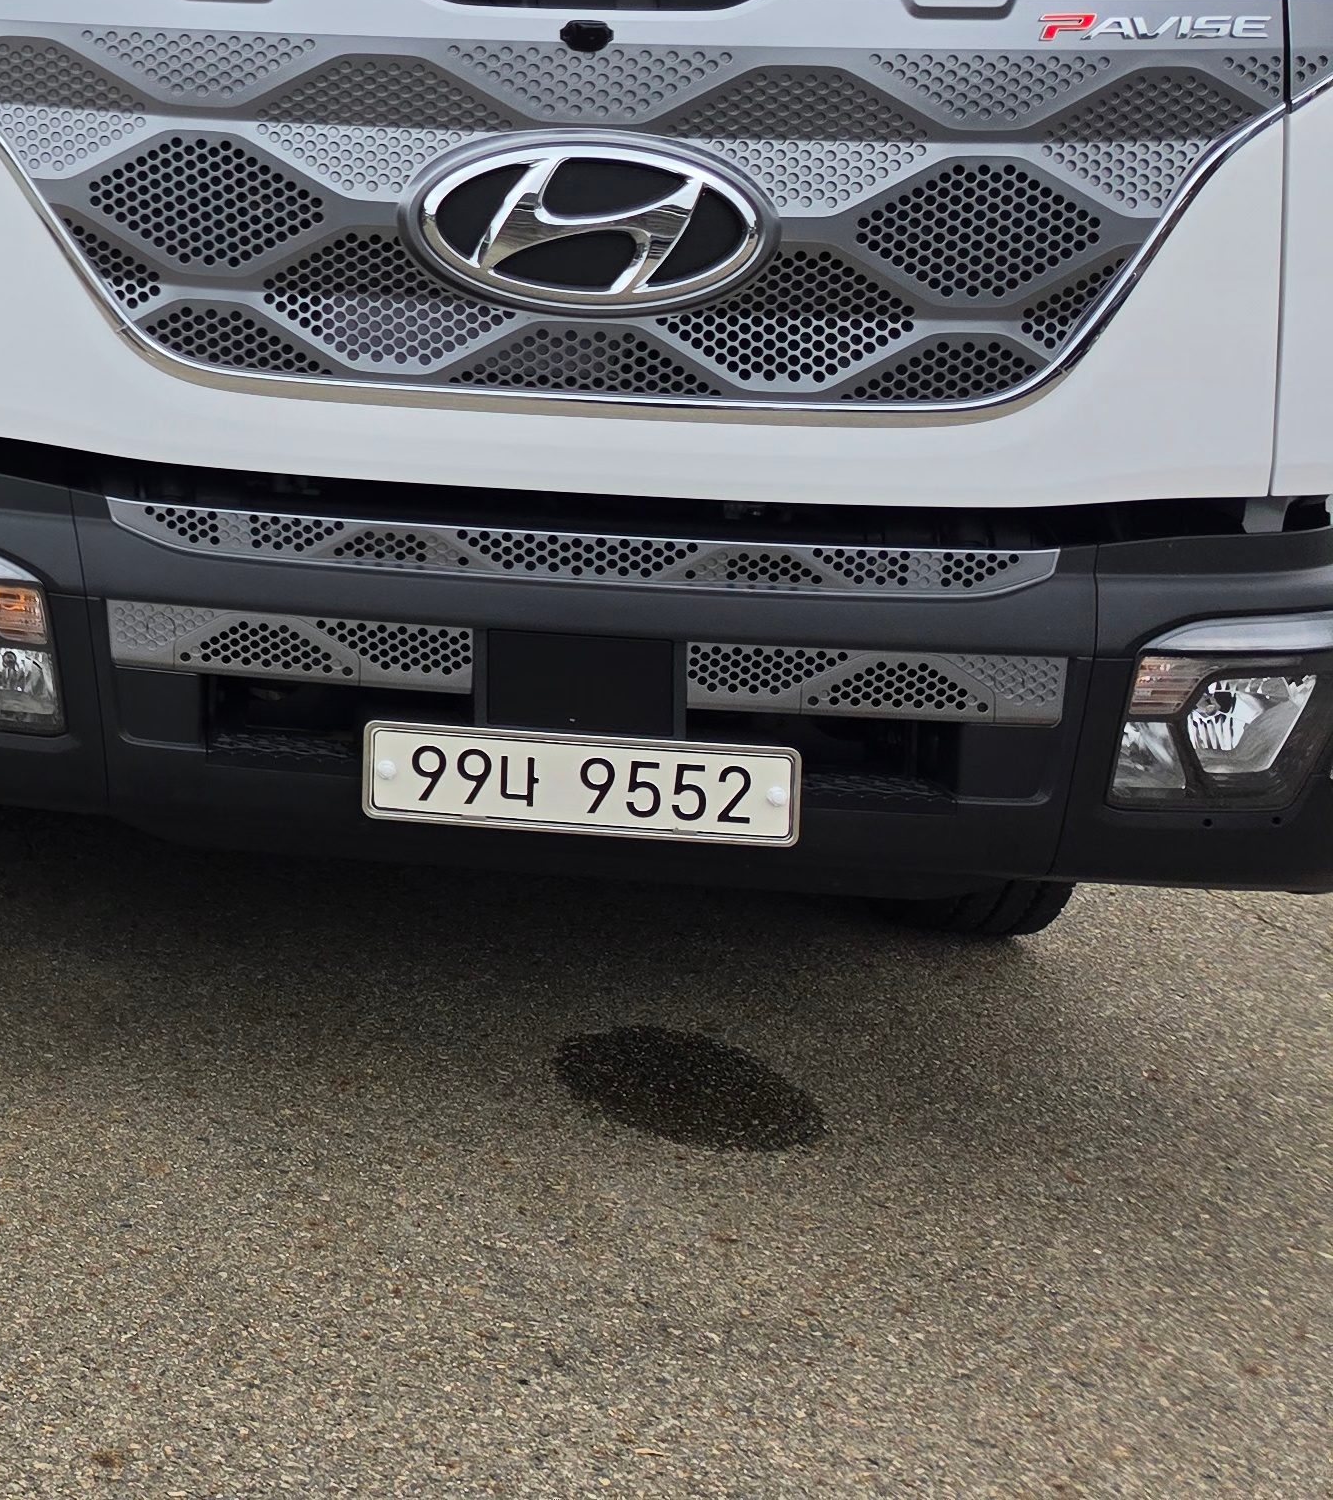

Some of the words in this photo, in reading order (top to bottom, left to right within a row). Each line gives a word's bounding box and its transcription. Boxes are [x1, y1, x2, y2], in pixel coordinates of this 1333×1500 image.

[1037, 12, 1272, 41] PAVISE
[410, 744, 540, 807] 99나
[579, 756, 752, 824] 9552
